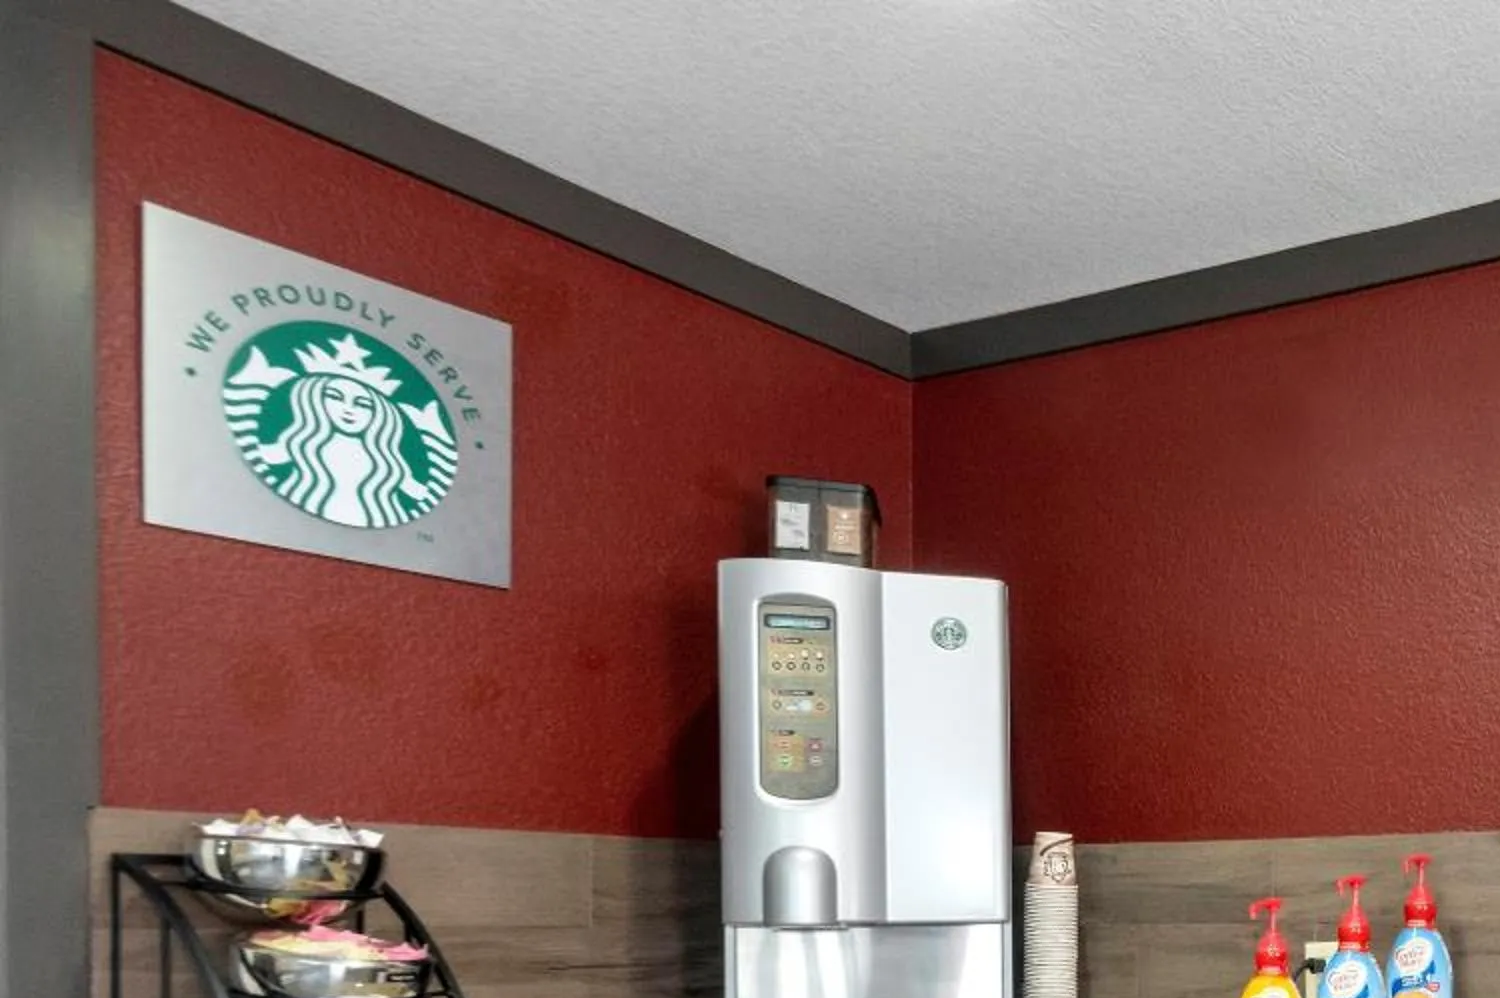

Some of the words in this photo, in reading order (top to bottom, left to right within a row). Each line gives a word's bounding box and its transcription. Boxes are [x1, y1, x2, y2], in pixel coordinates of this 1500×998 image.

[186, 310, 230, 355] WE
[231, 283, 397, 330] PROUDLY
[405, 332, 482, 426] SERVE
